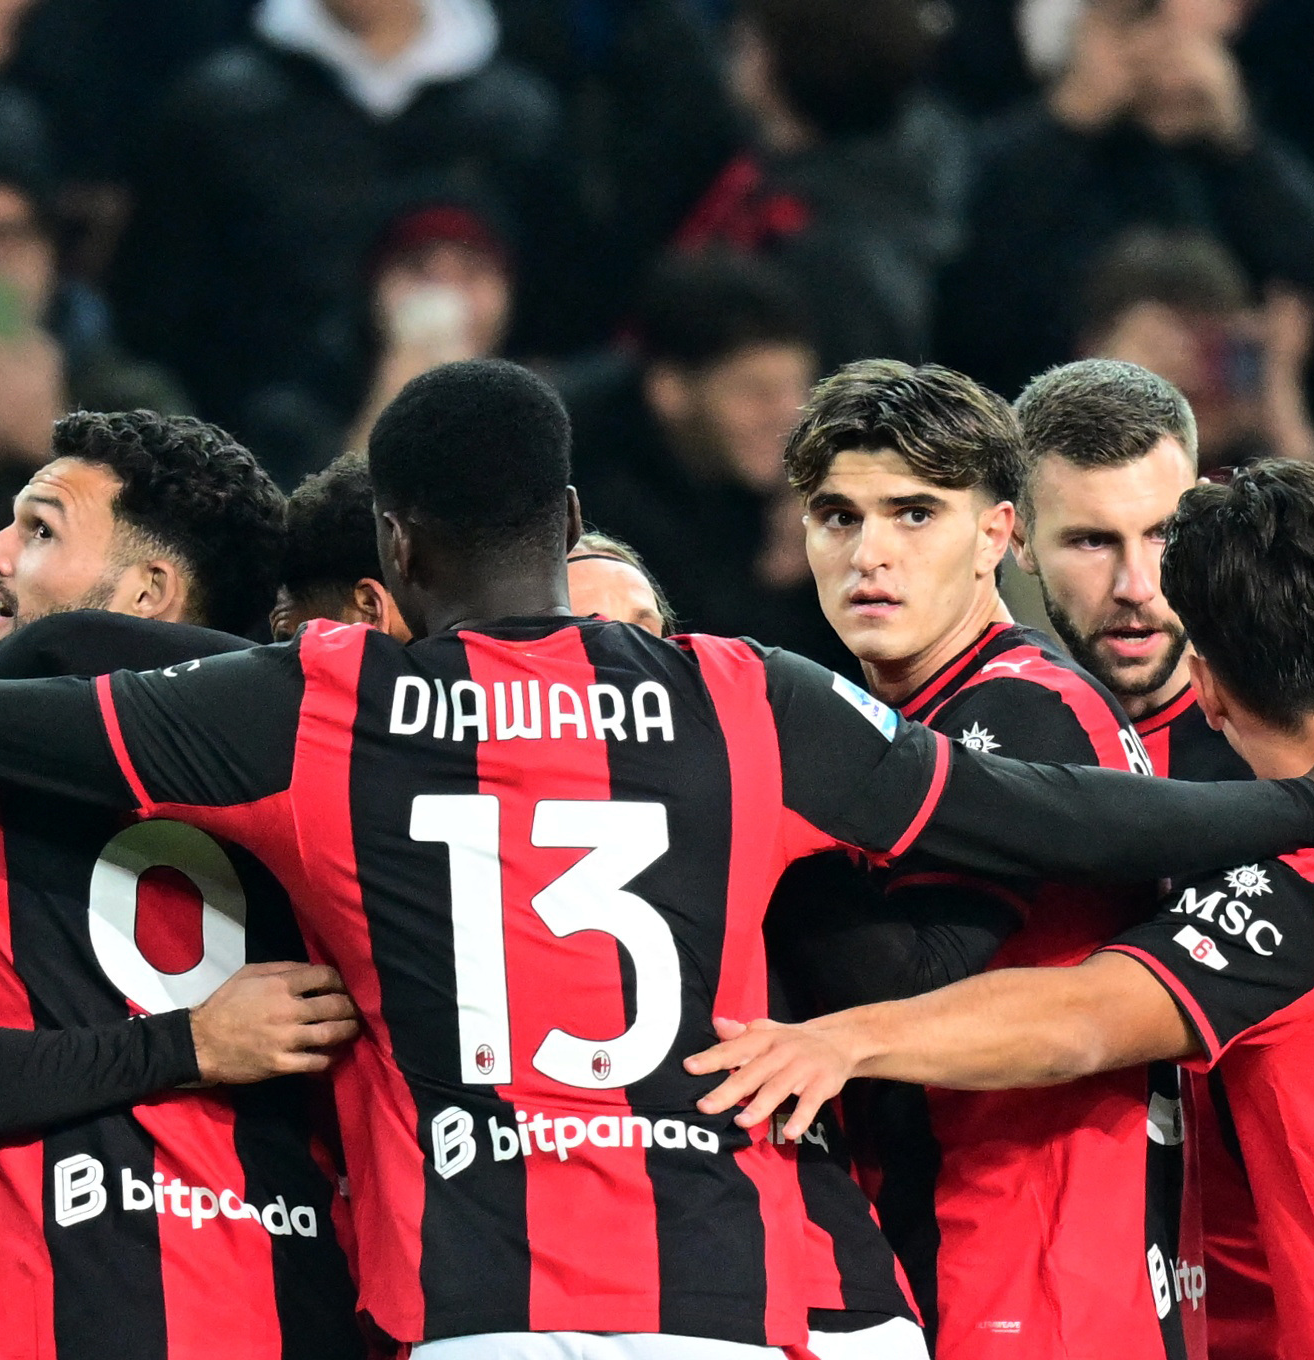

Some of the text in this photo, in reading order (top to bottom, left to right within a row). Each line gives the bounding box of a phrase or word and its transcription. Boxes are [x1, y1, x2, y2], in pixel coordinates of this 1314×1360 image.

[389, 675, 675, 743] DIAWARA
[410, 794, 682, 1089] 13
[1170, 887, 1283, 956] MSC
[1192, 938, 1213, 960] 6
